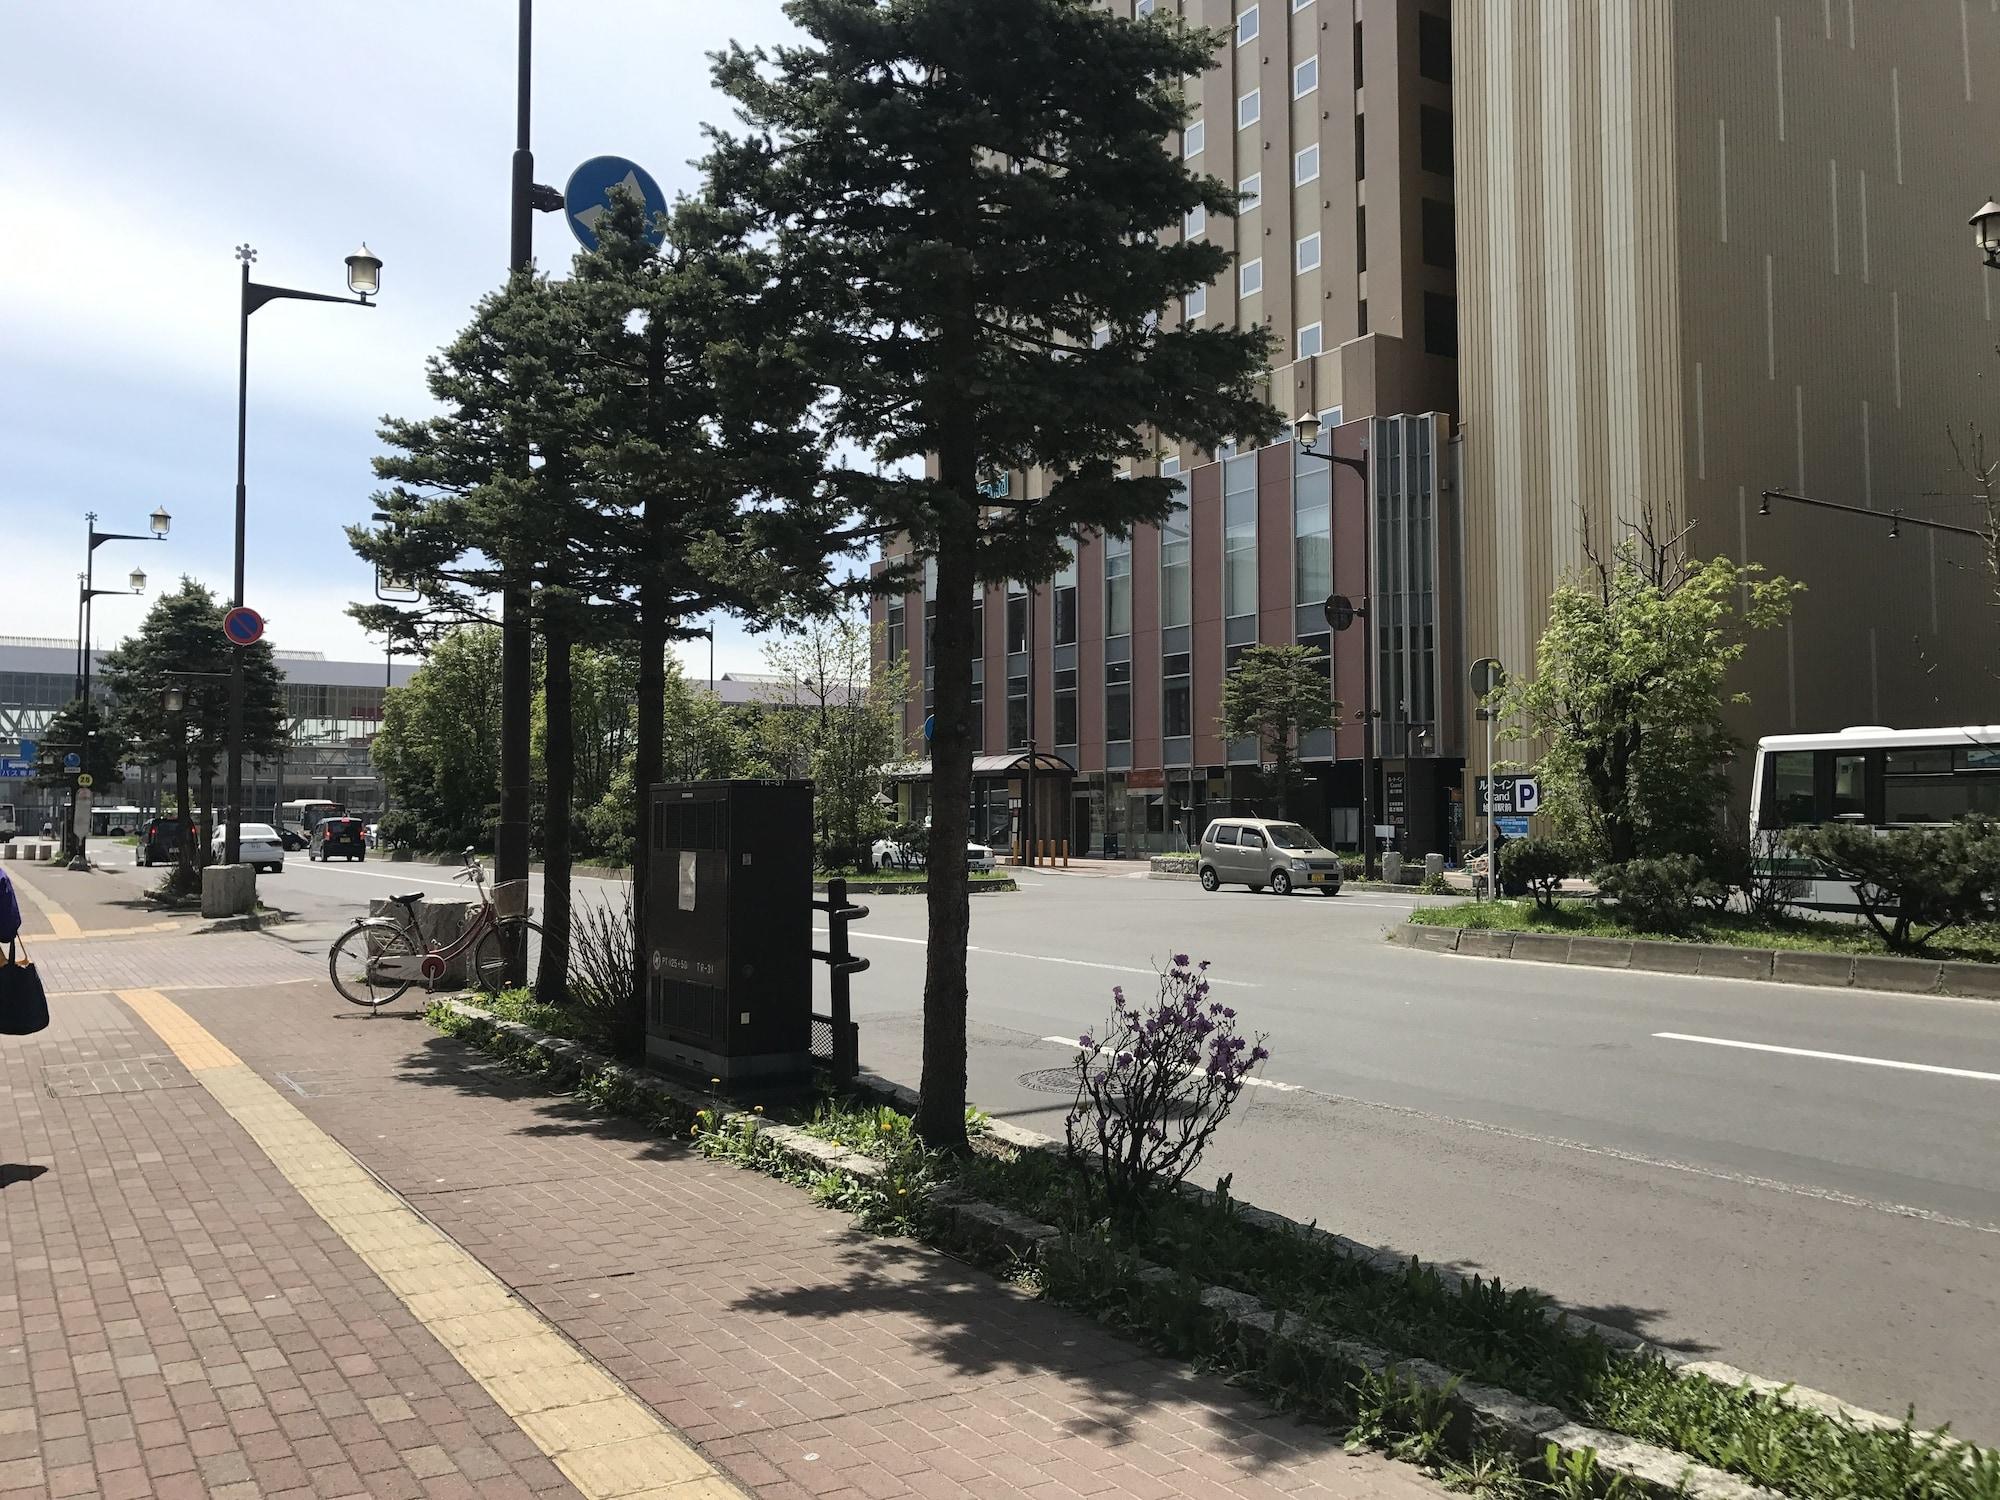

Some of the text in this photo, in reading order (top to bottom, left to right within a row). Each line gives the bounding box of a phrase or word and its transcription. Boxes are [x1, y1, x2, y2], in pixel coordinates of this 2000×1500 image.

[1479, 779, 1515, 791] ルトイン
[1484, 791, 1510, 801] Gand
[1520, 784, 1535, 808] P
